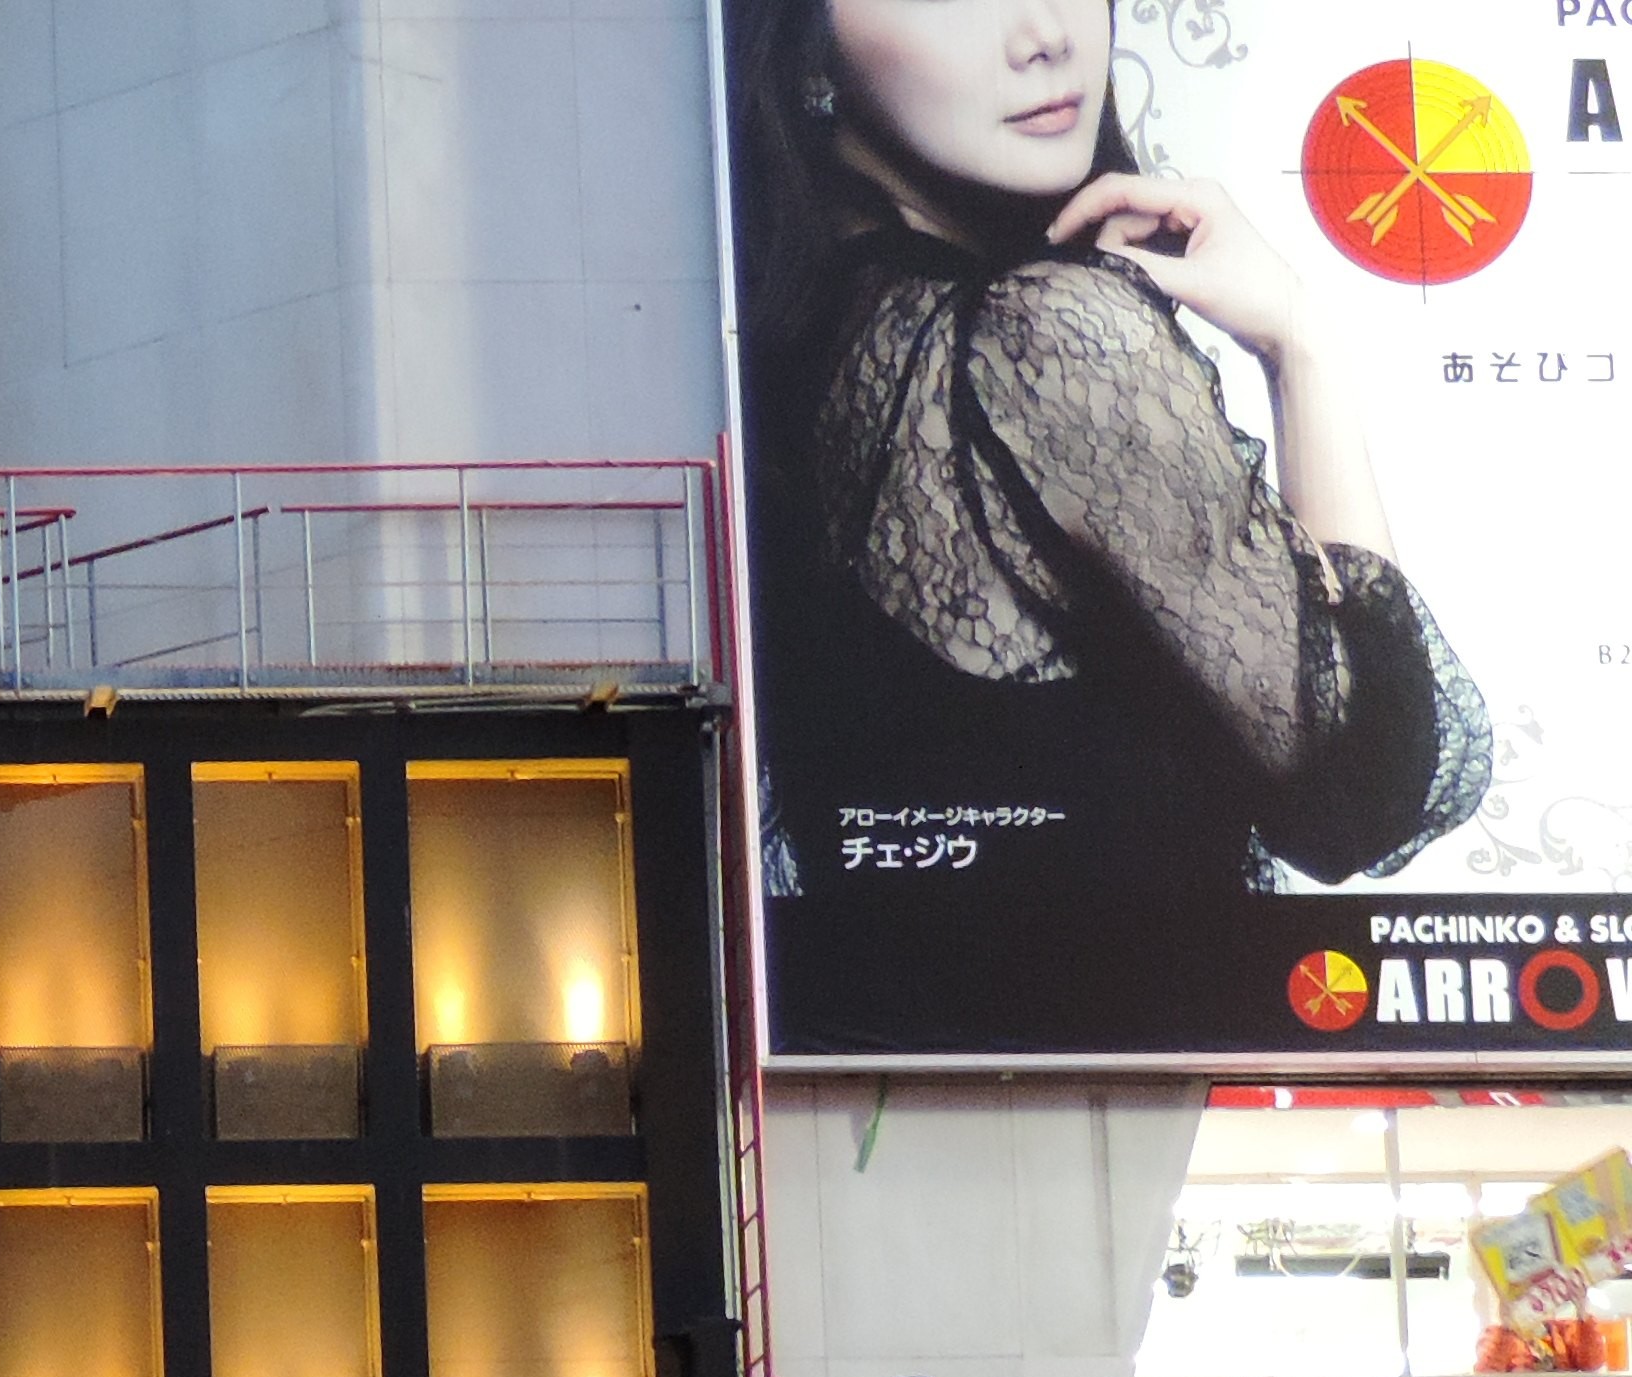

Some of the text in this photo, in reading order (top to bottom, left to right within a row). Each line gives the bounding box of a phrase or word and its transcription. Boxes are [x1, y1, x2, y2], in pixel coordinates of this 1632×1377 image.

[838, 807, 1066, 826] アローイメージキャラクター
[841, 834, 978, 870] チェ・ジウ
[1369, 916, 1545, 943] PACHINKO
[1554, 915, 1581, 943] &
